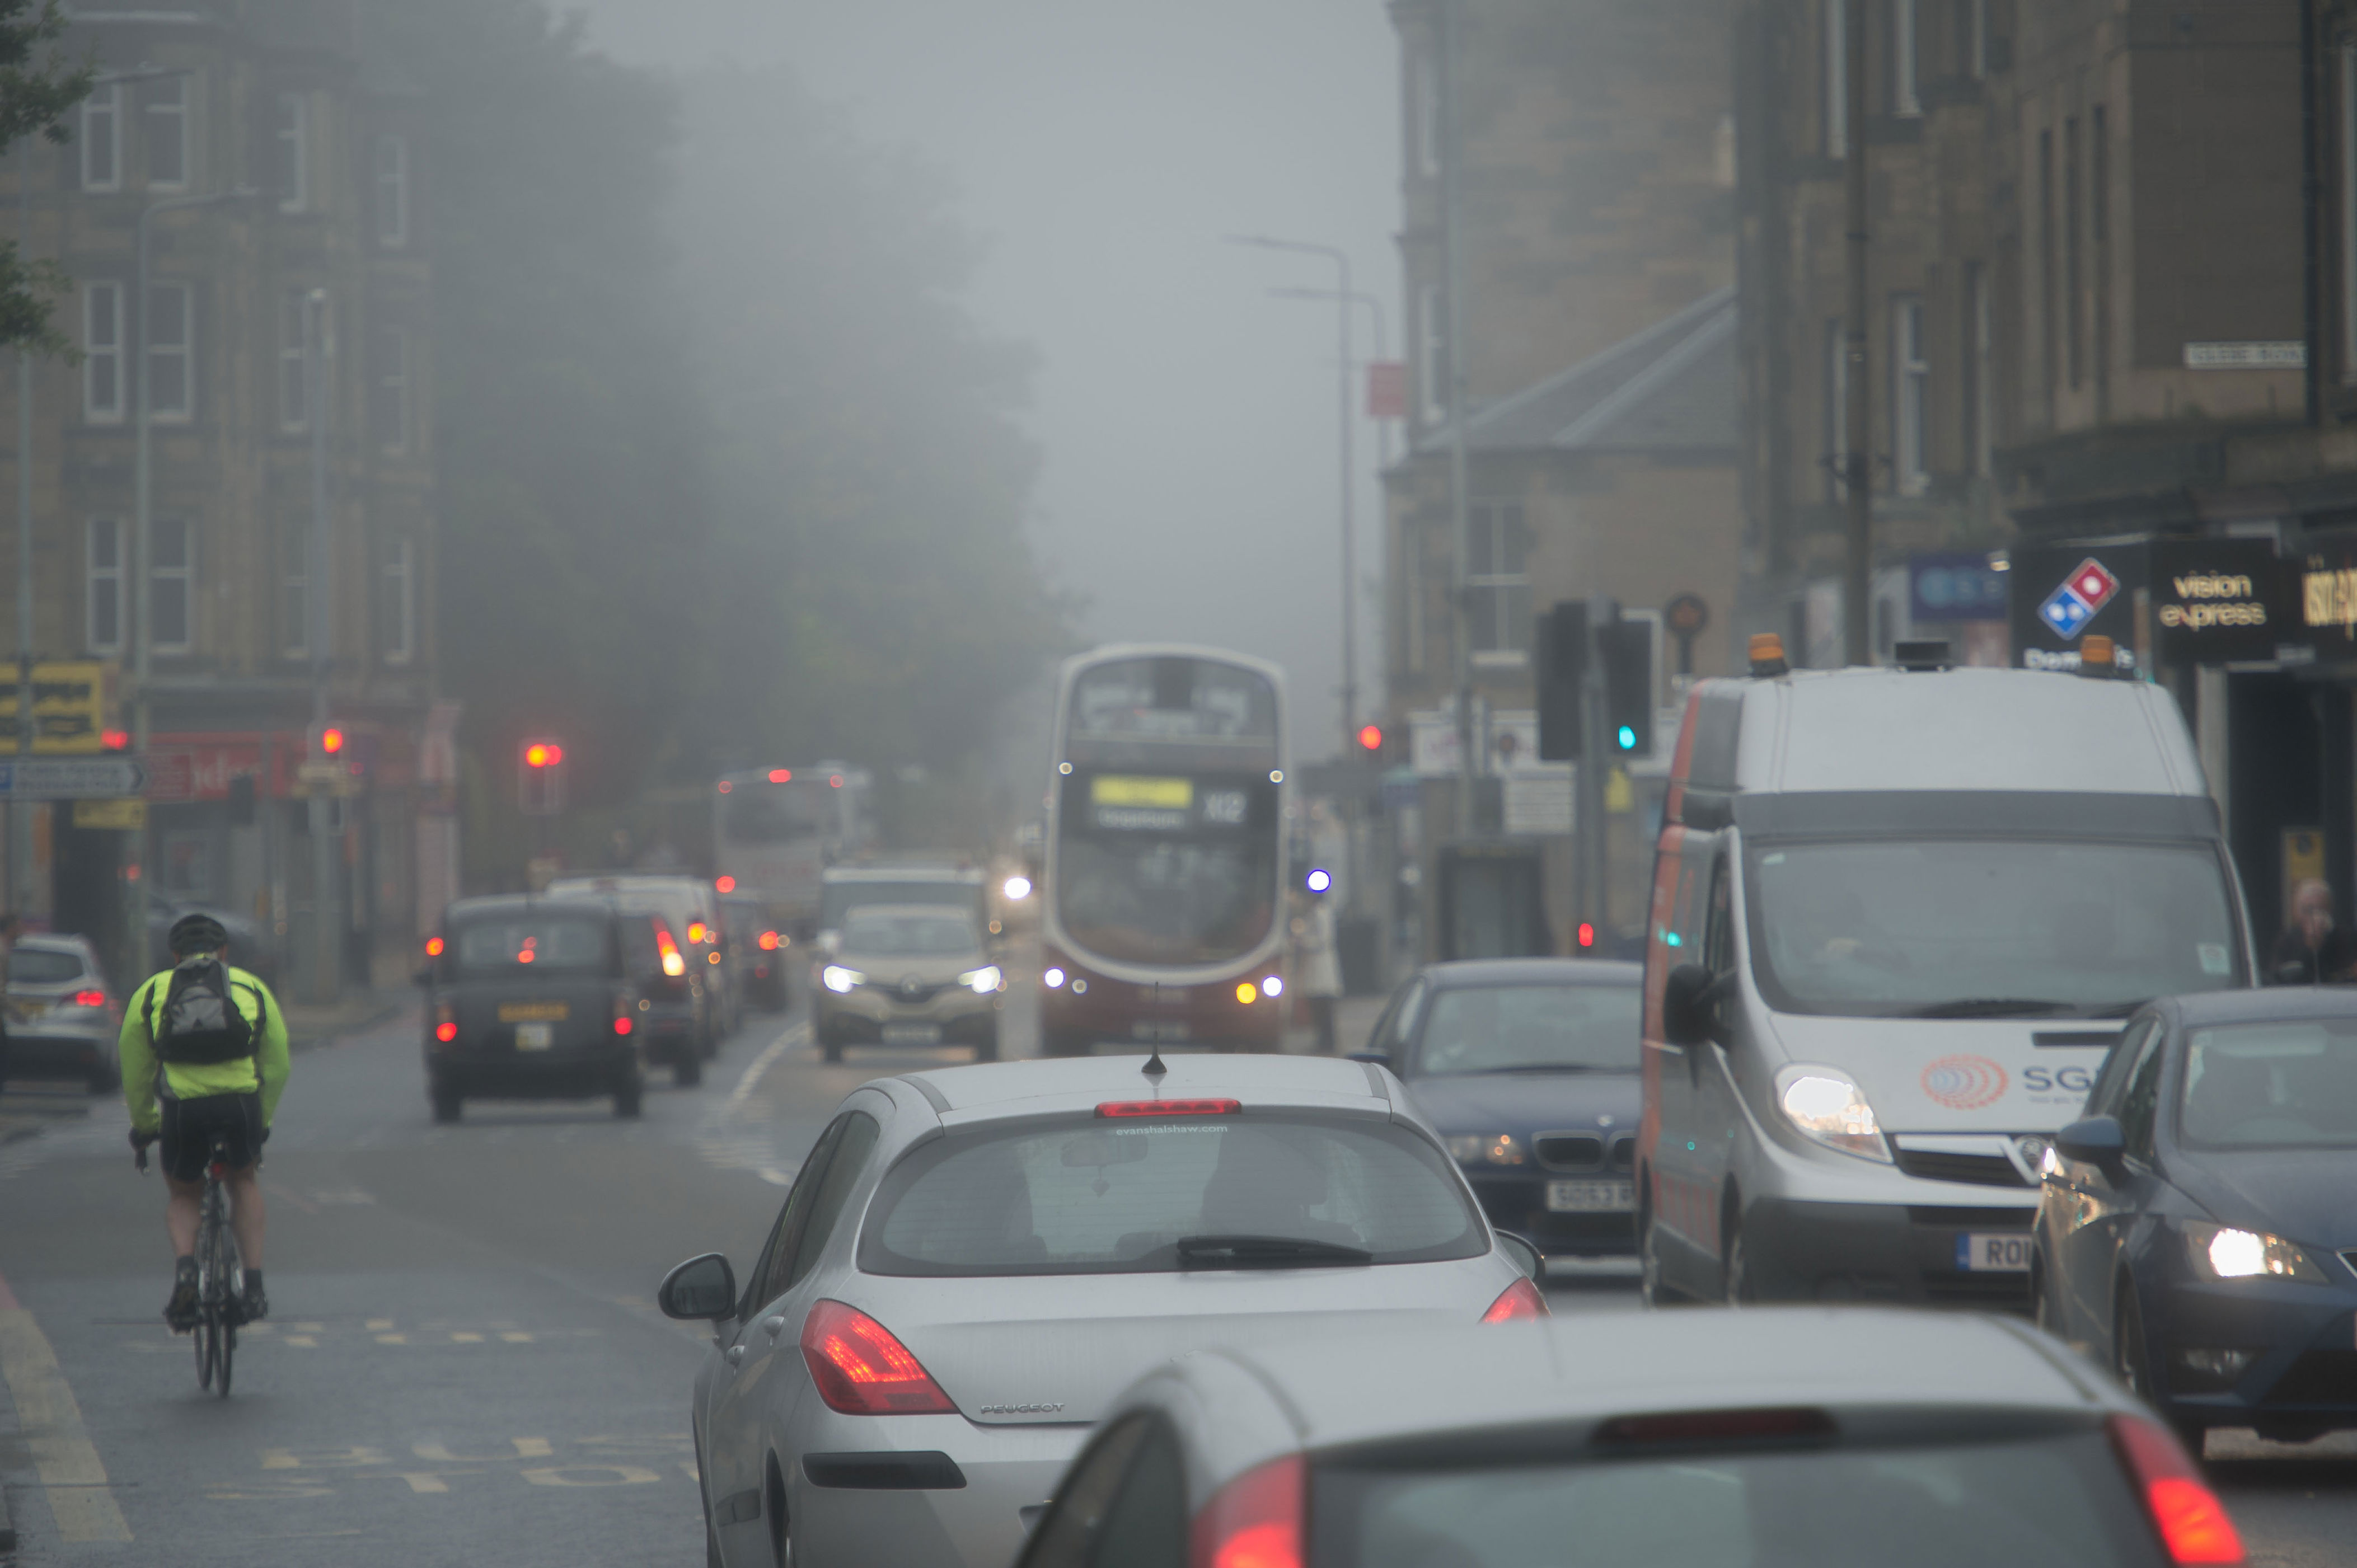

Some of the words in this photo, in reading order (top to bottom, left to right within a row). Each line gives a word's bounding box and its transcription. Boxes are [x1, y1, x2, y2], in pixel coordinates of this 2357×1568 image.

[2173, 570, 2251, 598] vision
[2159, 603, 2266, 632] express
[2022, 1065, 2099, 1092] SG
[1116, 1124, 1227, 1136] evanshalshaw.com
[980, 1402, 1065, 1414] PEUGEOT
[202, 1462, 700, 1500] STO
